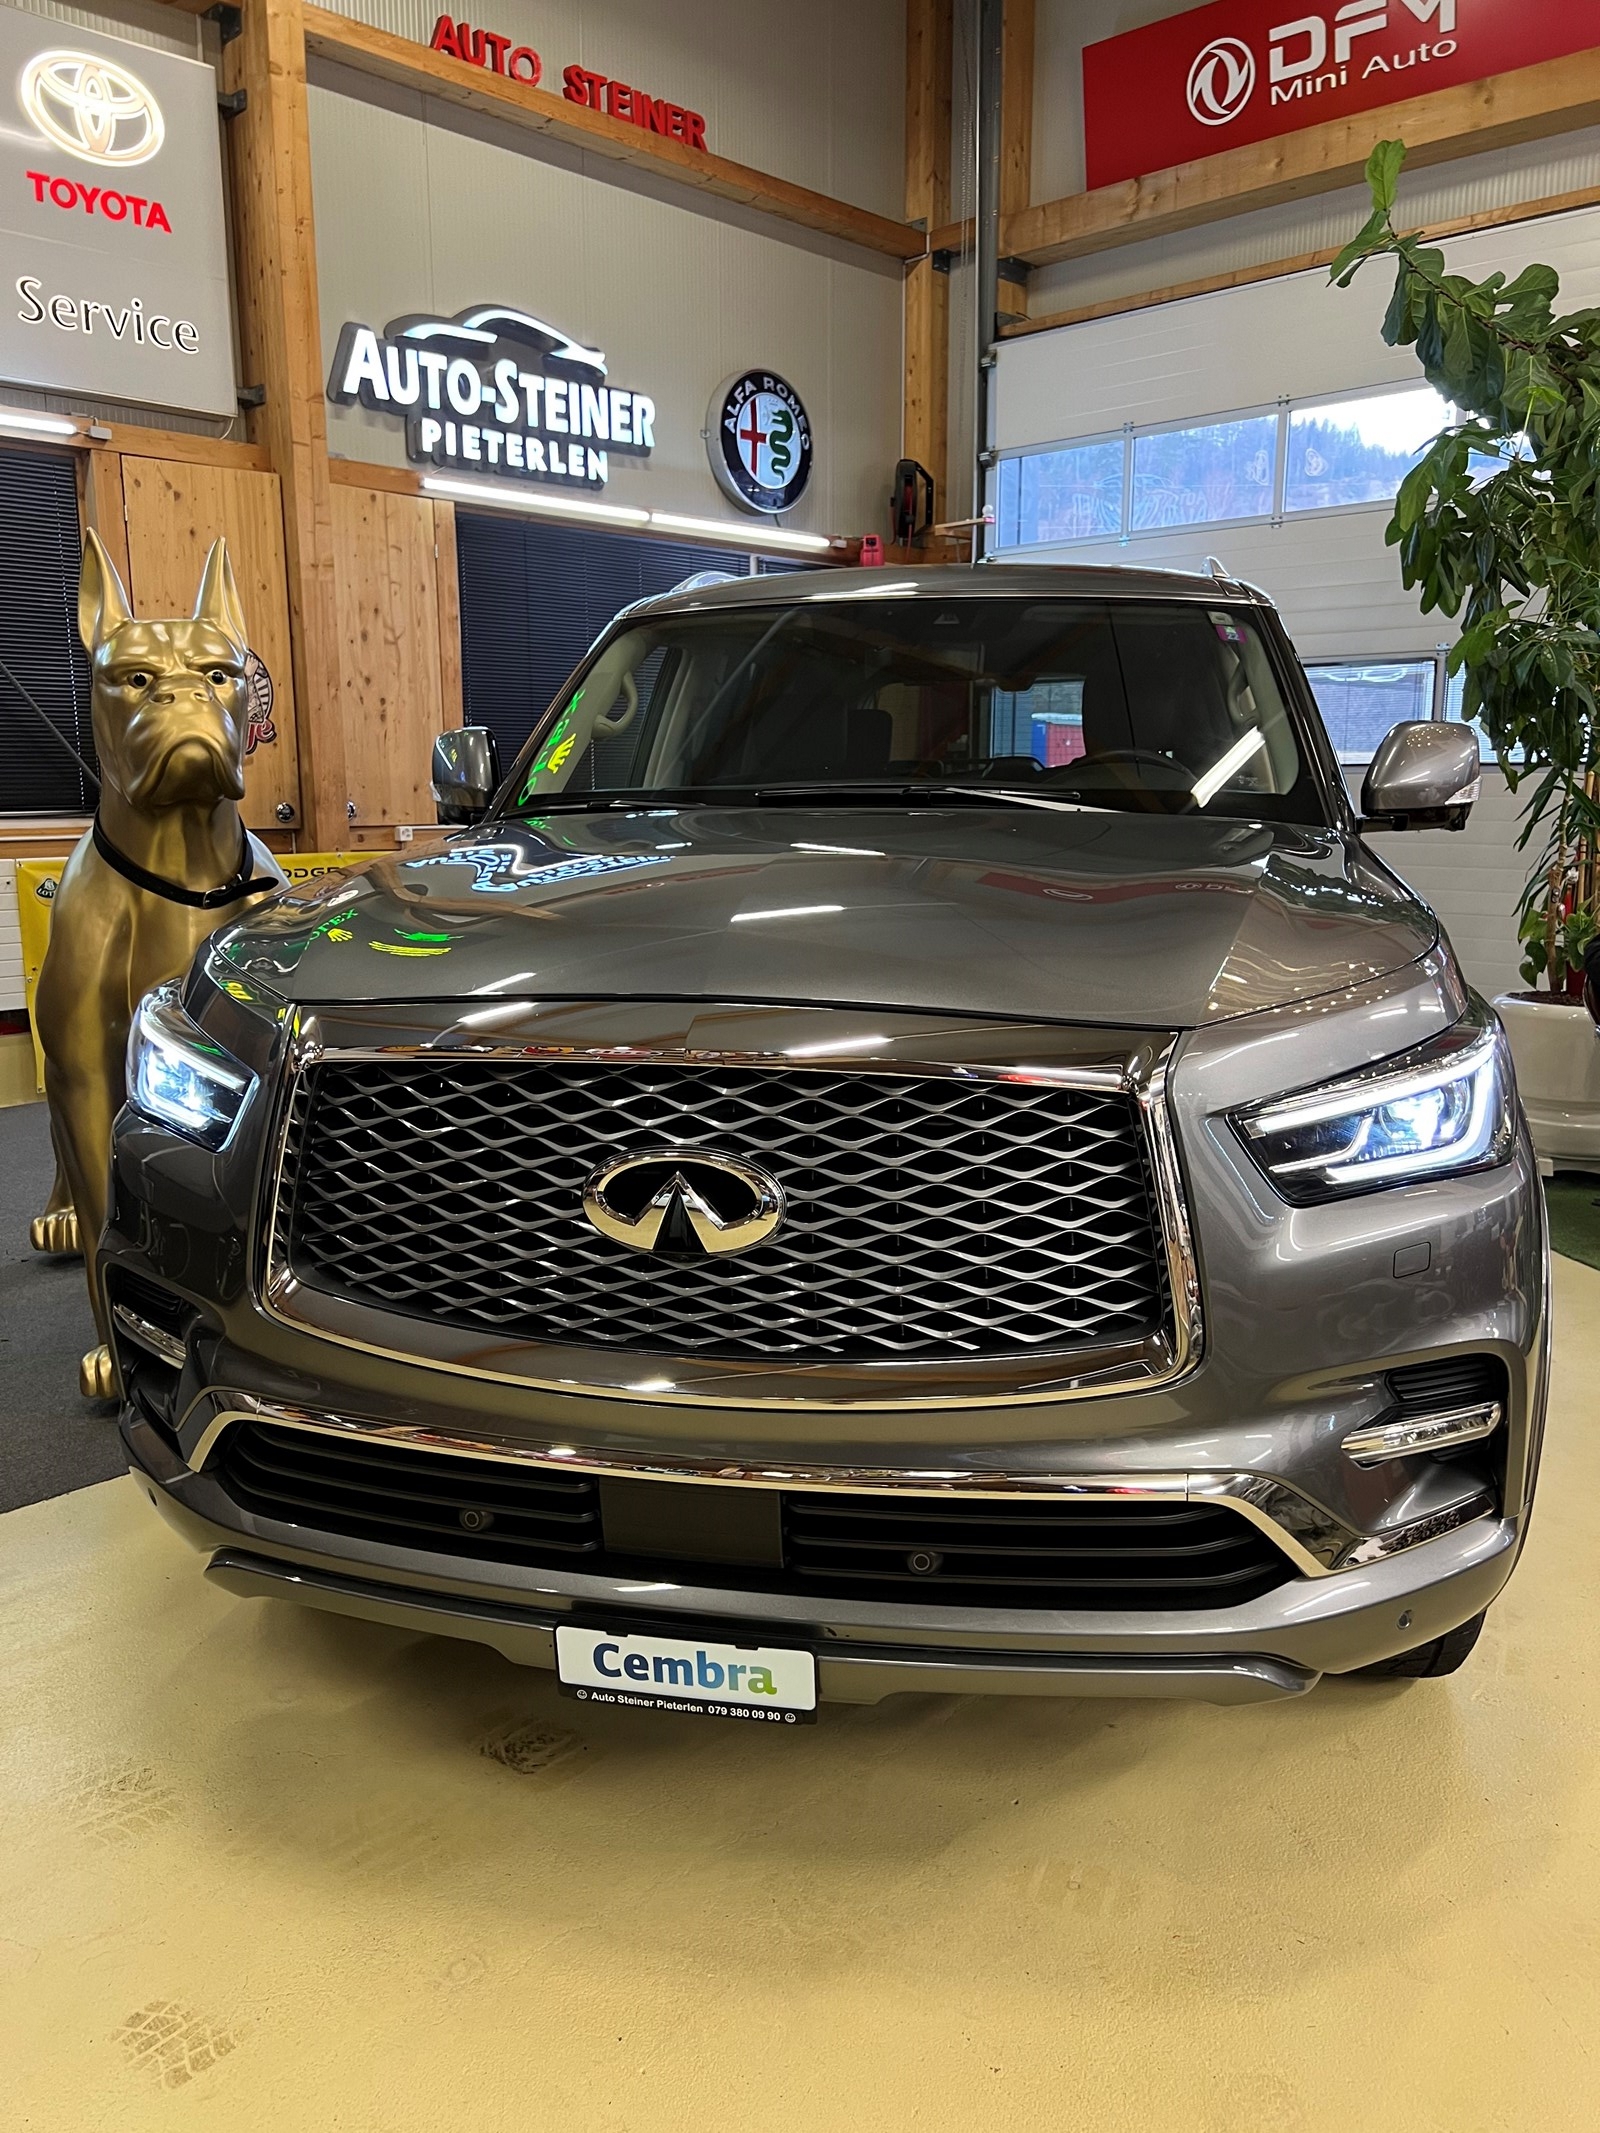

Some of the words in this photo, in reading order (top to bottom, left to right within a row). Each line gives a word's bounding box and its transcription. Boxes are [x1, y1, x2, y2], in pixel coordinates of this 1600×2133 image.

[1269, 0, 1456, 83] DFM
[1270, 65, 1347, 105] Mini
[1361, 39, 1457, 79] Auto
[429, 14, 543, 87] AUTO
[562, 64, 708, 151] STEINER
[26, 170, 173, 234] TOYOTA
[15, 275, 200, 355] Service
[342, 327, 656, 447] AUTO-STEINER
[724, 379, 758, 434] ALFA
[763, 376, 810, 450] ROMEO
[421, 417, 609, 483] PIETERLEN
[592, 1642, 778, 1695] Cembra
[591, 1691, 615, 1703] Auto
[617, 1695, 655, 1708] Steiner
[656, 1699, 704, 1713] Pieterlen
[707, 1705, 728, 1716] 079
[729, 1707, 750, 1718] 380
[751, 1709, 765, 1719] 09
[766, 1711, 781, 1721] 90
